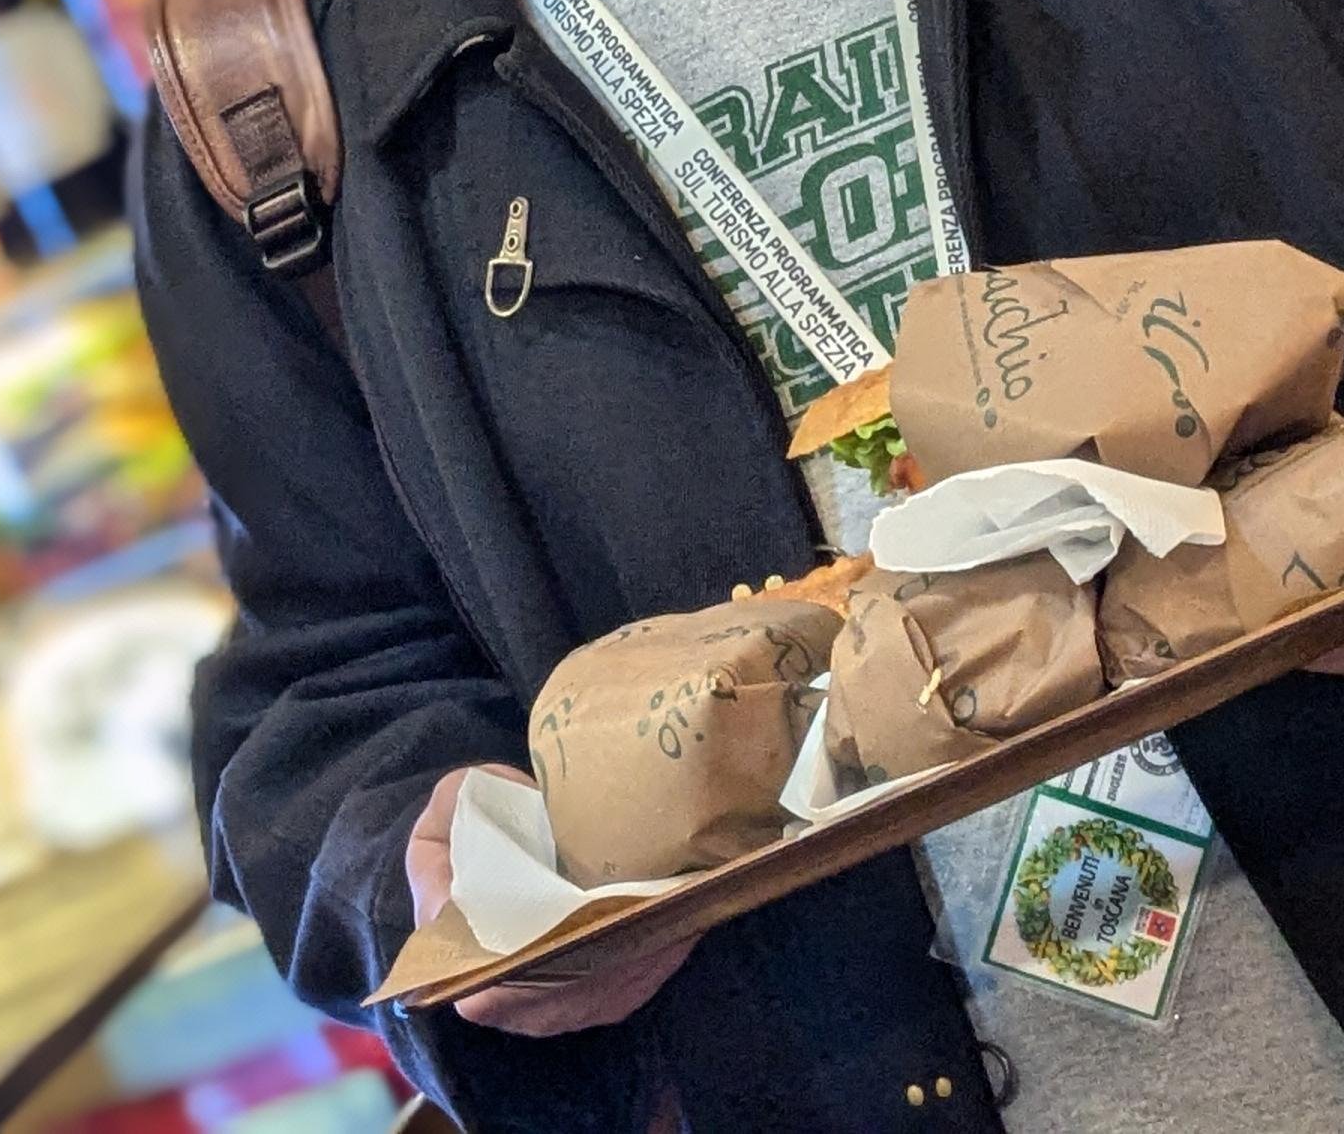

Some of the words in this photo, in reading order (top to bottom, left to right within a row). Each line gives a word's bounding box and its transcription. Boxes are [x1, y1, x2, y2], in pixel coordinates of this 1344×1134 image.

[587, 49, 625, 95] ALLA
[618, 88, 668, 149] SPEZIA
[592, 18, 685, 136] PROGRAMMATICA
[675, 162, 705, 199] SUL
[703, 192, 768, 271] TURISMO
[761, 269, 804, 319] ALLA
[799, 313, 857, 380] SPEZIA
[693, 148, 771, 243] CONFERENZA
[767, 237, 874, 368] PROGRAMMATICA
[1062, 855, 1101, 940] BENVENUTI
[1097, 874, 1132, 945] TOSCANA
